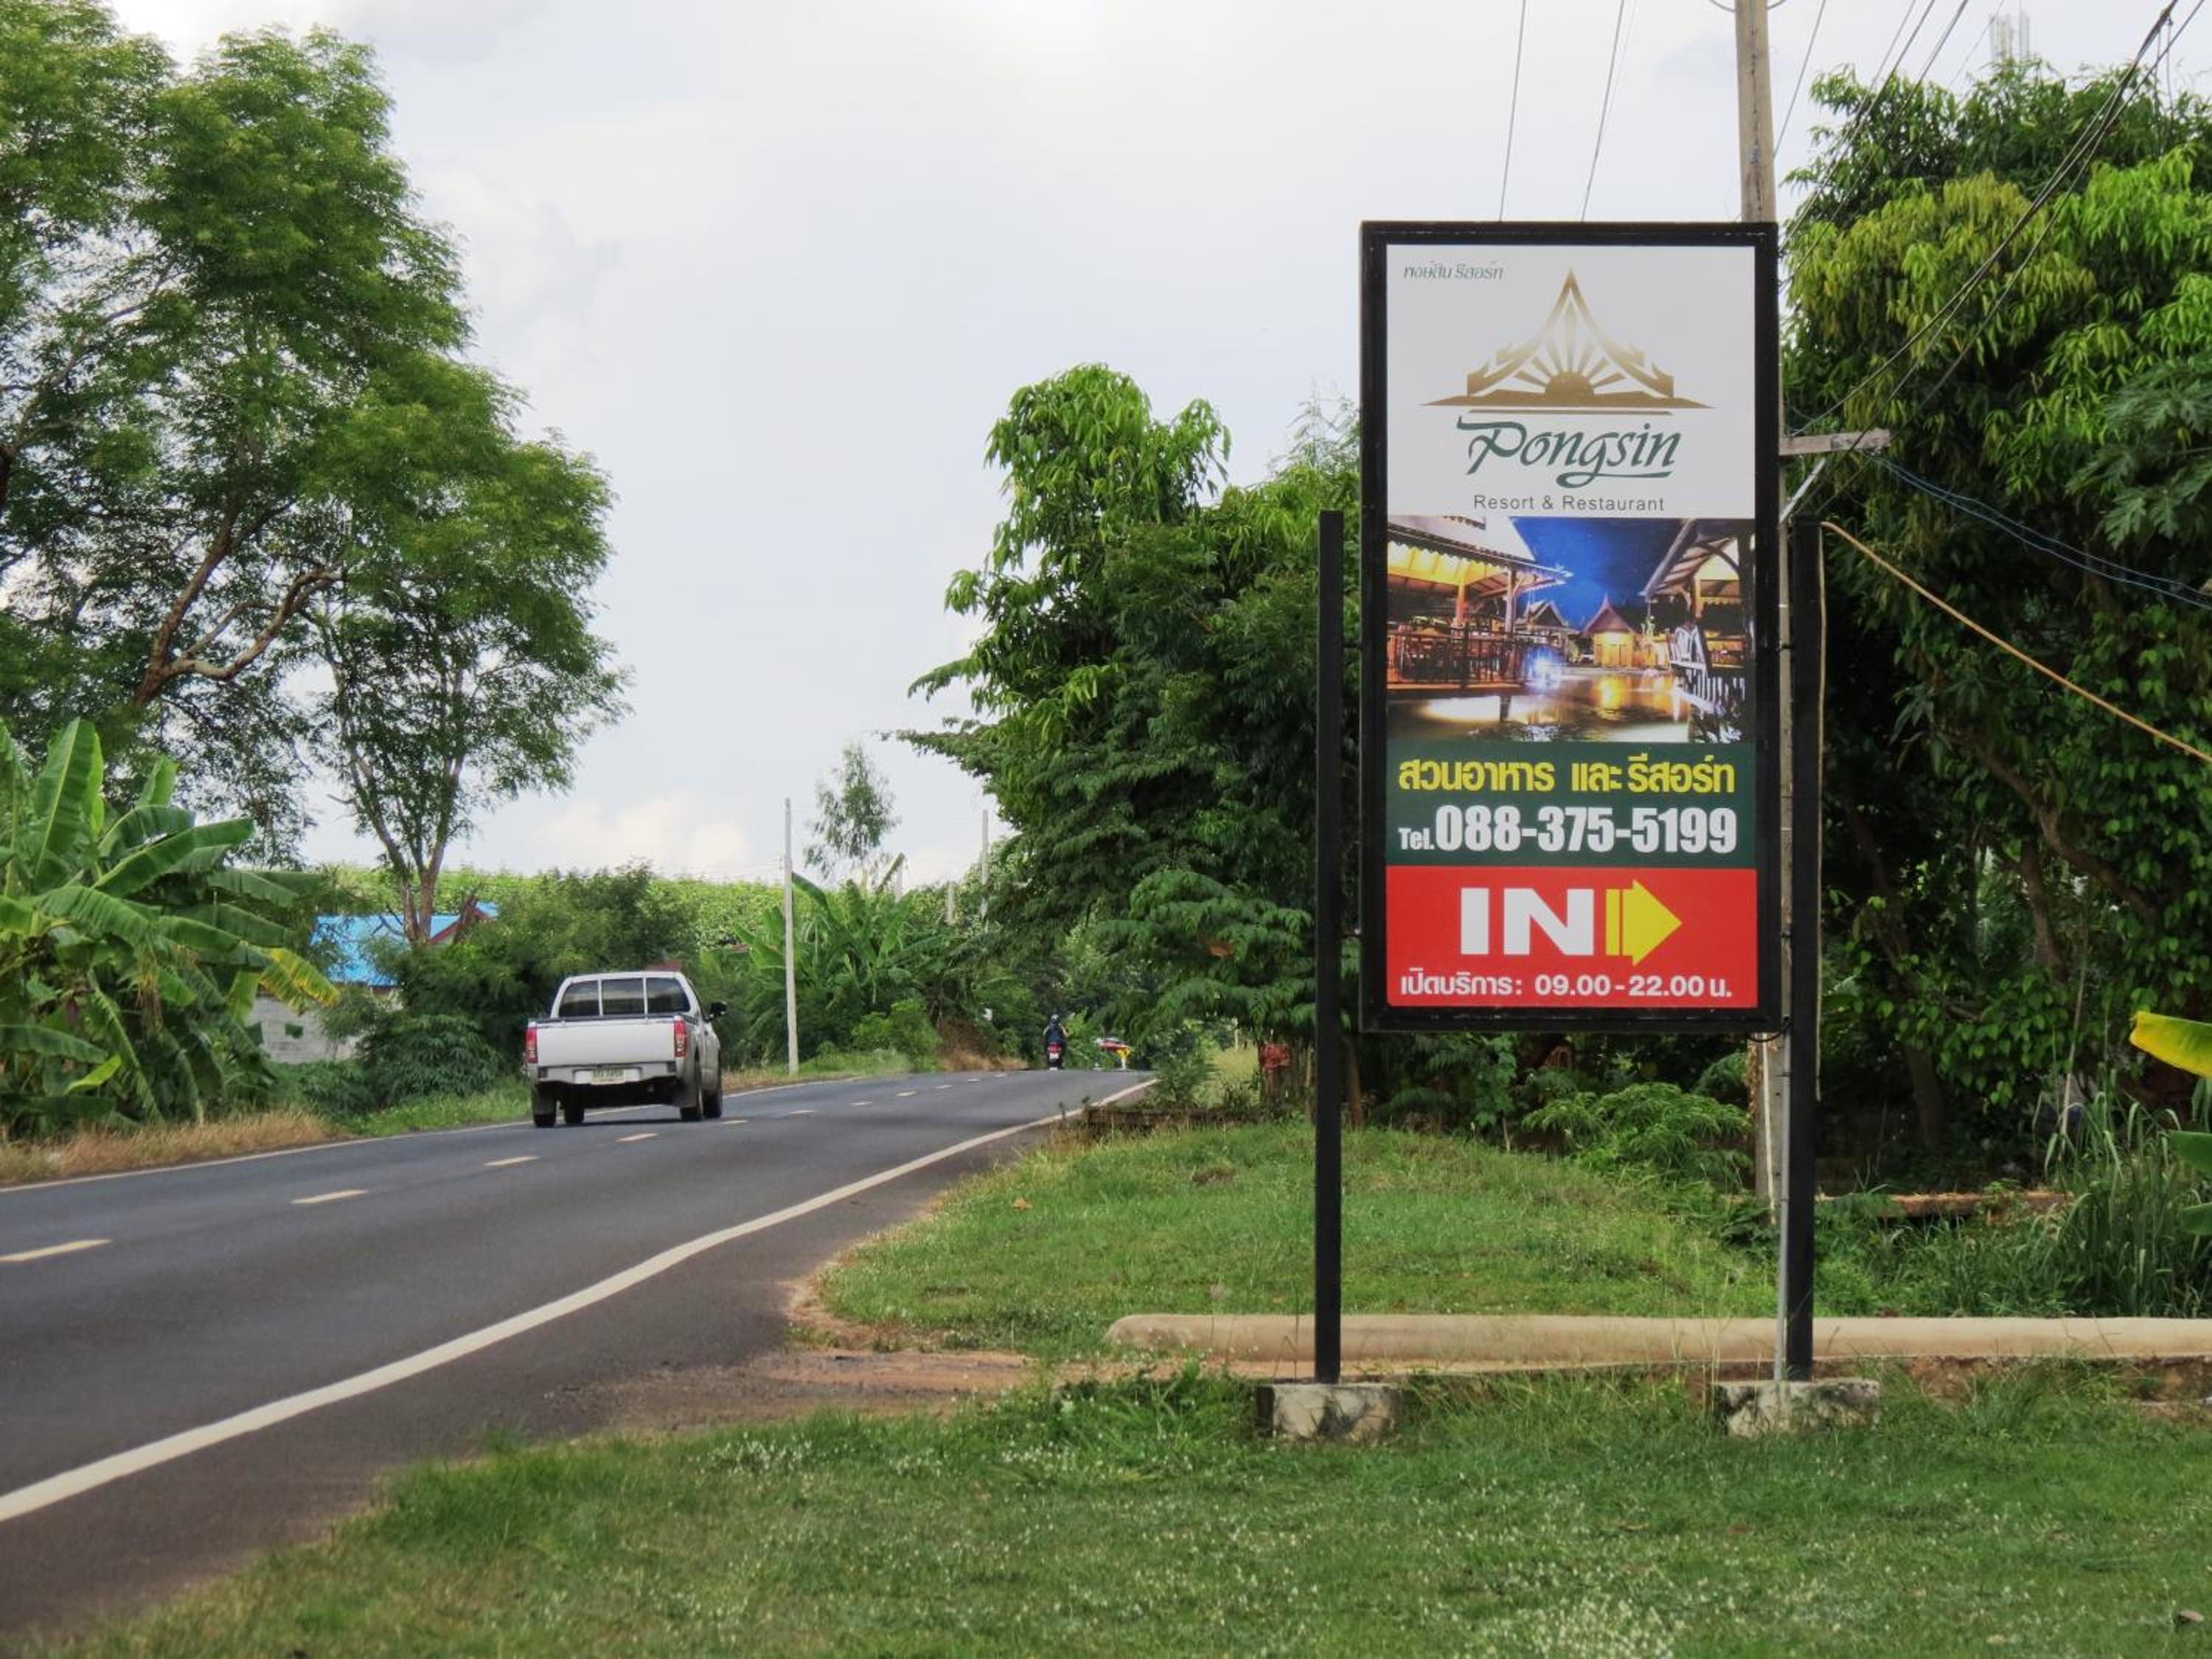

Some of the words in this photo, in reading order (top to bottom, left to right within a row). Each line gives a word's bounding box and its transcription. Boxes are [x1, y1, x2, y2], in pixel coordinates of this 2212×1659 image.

[1456, 416, 1682, 488] Pongsin
[1474, 494, 1534, 509] Resort
[1542, 495, 1554, 510] &
[1562, 495, 1664, 511] Restaurant
[1399, 759, 1557, 792] สวนอาหาร
[1571, 762, 1623, 792] และ
[1627, 753, 1736, 794] รีสอร์ท
[1398, 827, 1435, 851] Tel.
[1435, 804, 1737, 854] 088-375-5199
[1460, 887, 1595, 956] IN
